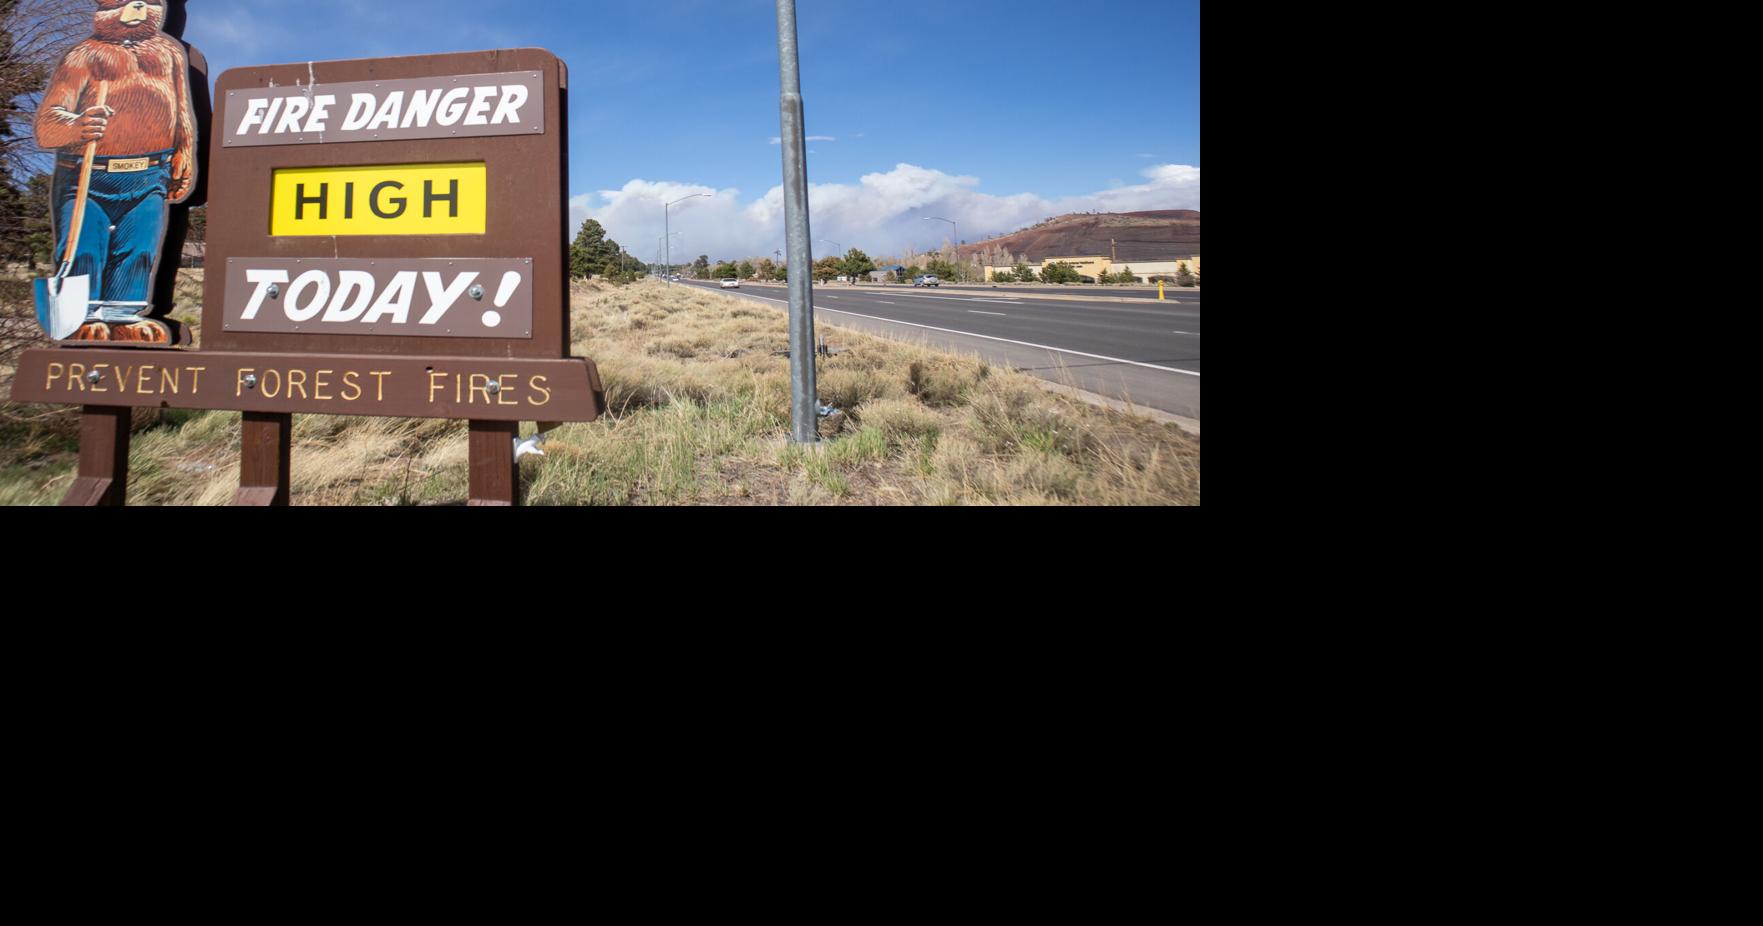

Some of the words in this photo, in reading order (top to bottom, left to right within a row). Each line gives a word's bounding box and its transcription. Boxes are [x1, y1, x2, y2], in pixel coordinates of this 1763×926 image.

[236, 94, 336, 134] FIRE
[341, 85, 528, 131] DANGER
[112, 162, 145, 170] SMOKEY
[295, 179, 459, 220] HIGH
[45, 363, 206, 394] PREVENT
[236, 368, 392, 401] FOREST
[429, 372, 551, 405] FIRES
